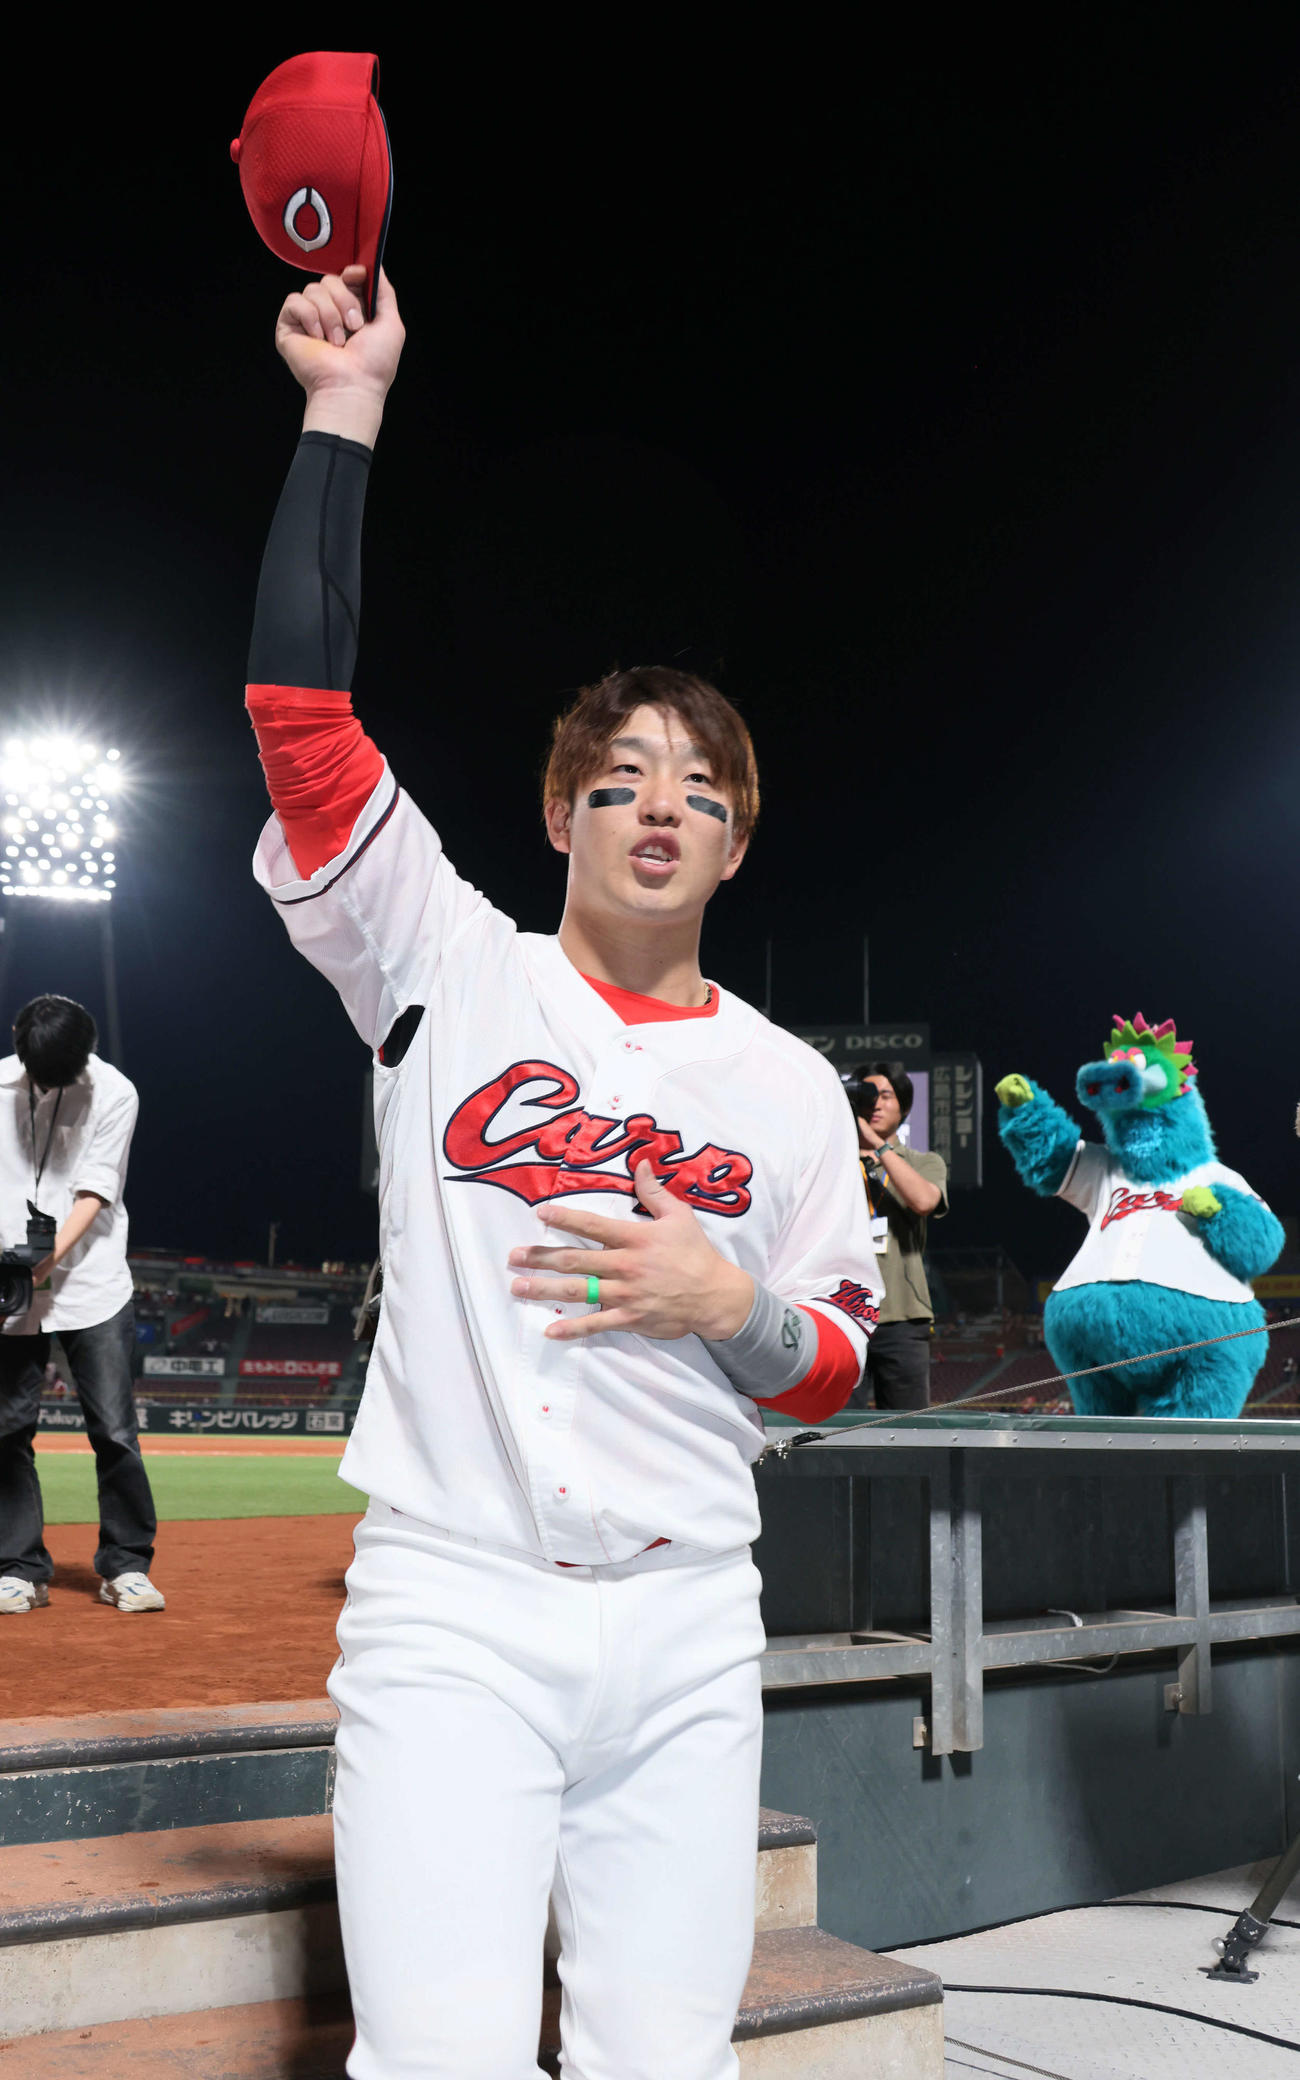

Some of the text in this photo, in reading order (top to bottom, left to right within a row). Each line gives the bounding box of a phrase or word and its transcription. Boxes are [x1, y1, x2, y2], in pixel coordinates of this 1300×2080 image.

[845, 1034, 923, 1050] DISCO
[443, 1059, 753, 1218] Carp
[168, 1410, 299, 1429] キリンビバレッジ
